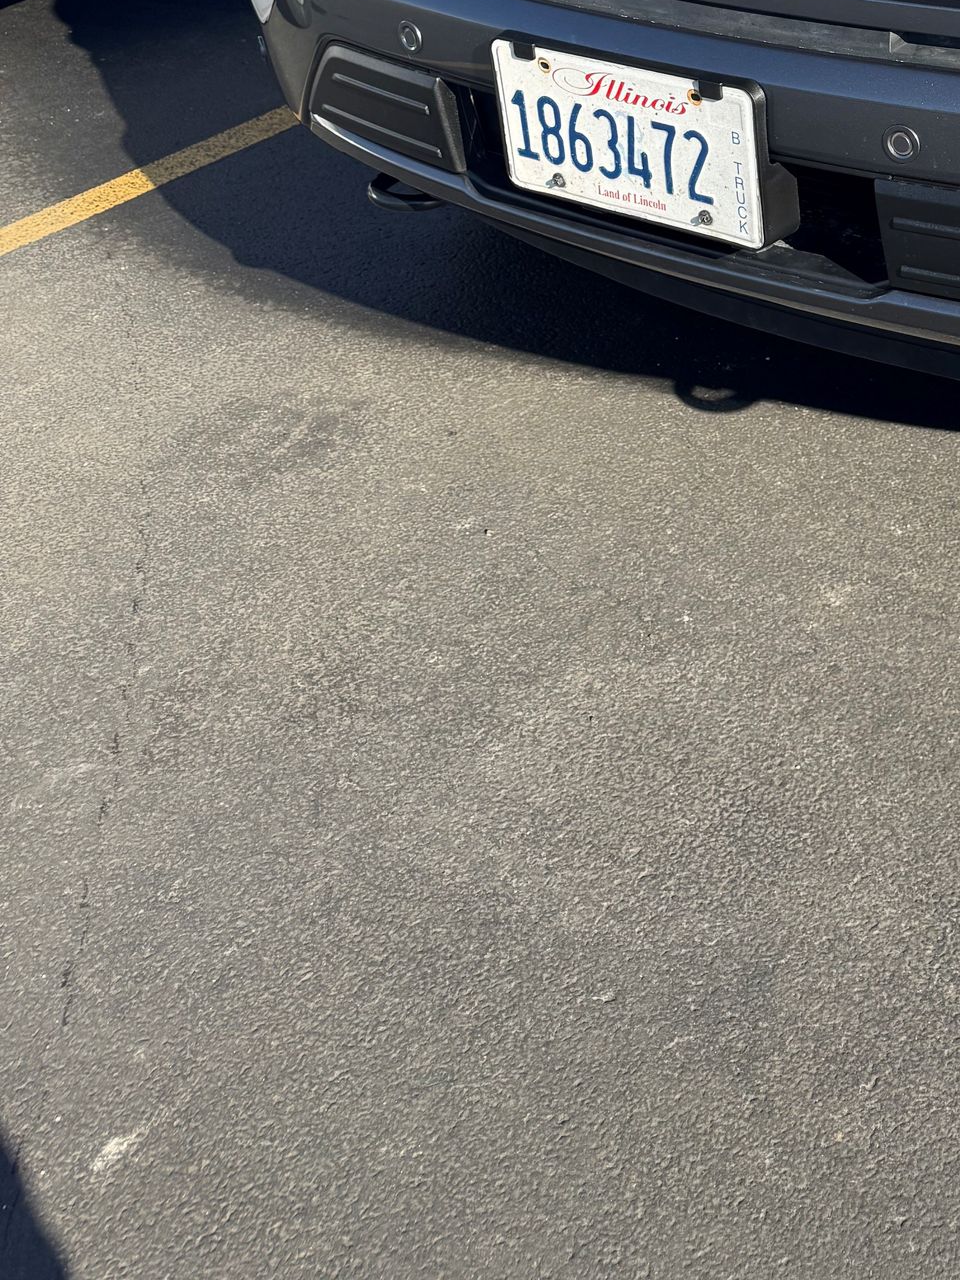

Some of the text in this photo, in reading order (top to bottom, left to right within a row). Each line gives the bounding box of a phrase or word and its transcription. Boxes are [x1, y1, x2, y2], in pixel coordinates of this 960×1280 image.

[553, 68, 688, 115] Illinois
[511, 89, 714, 205] 1863472
[731, 131, 749, 234] B TRUCK
[598, 184, 667, 212] Land of Lincoln
